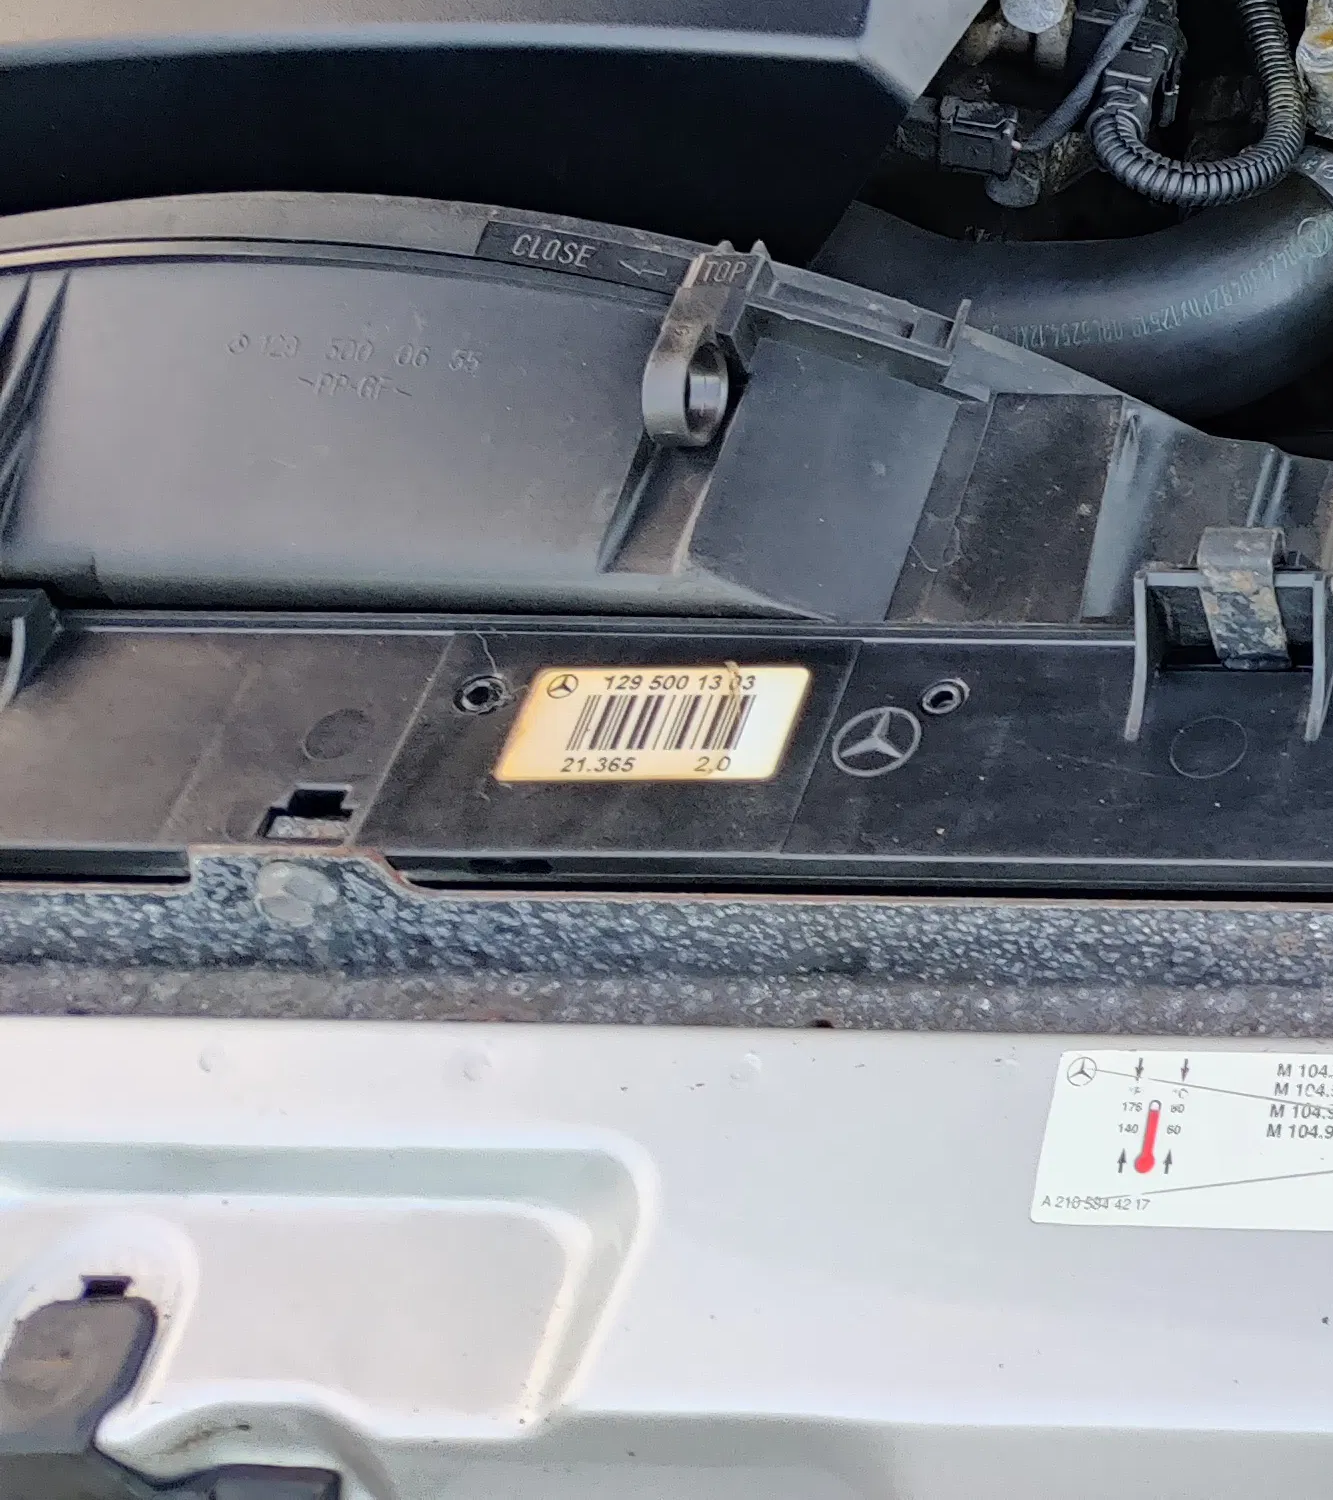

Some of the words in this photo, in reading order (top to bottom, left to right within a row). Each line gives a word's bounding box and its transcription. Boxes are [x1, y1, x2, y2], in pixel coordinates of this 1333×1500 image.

[512, 233, 597, 268] CLOSE
[702, 260, 747, 284] TOP
[604, 674, 642, 690] 129
[648, 674, 689, 690] 500
[698, 674, 721, 690] 13
[560, 756, 635, 773] 21.365
[1277, 1063, 1292, 1077] M
[1274, 1082, 1289, 1097] M
[1270, 1103, 1285, 1118] M
[1266, 1123, 1282, 1138] M
[1041, 1195, 1052, 1207] A
[1115, 1198, 1132, 1211] 42
[1136, 1199, 1150, 1211] 17
